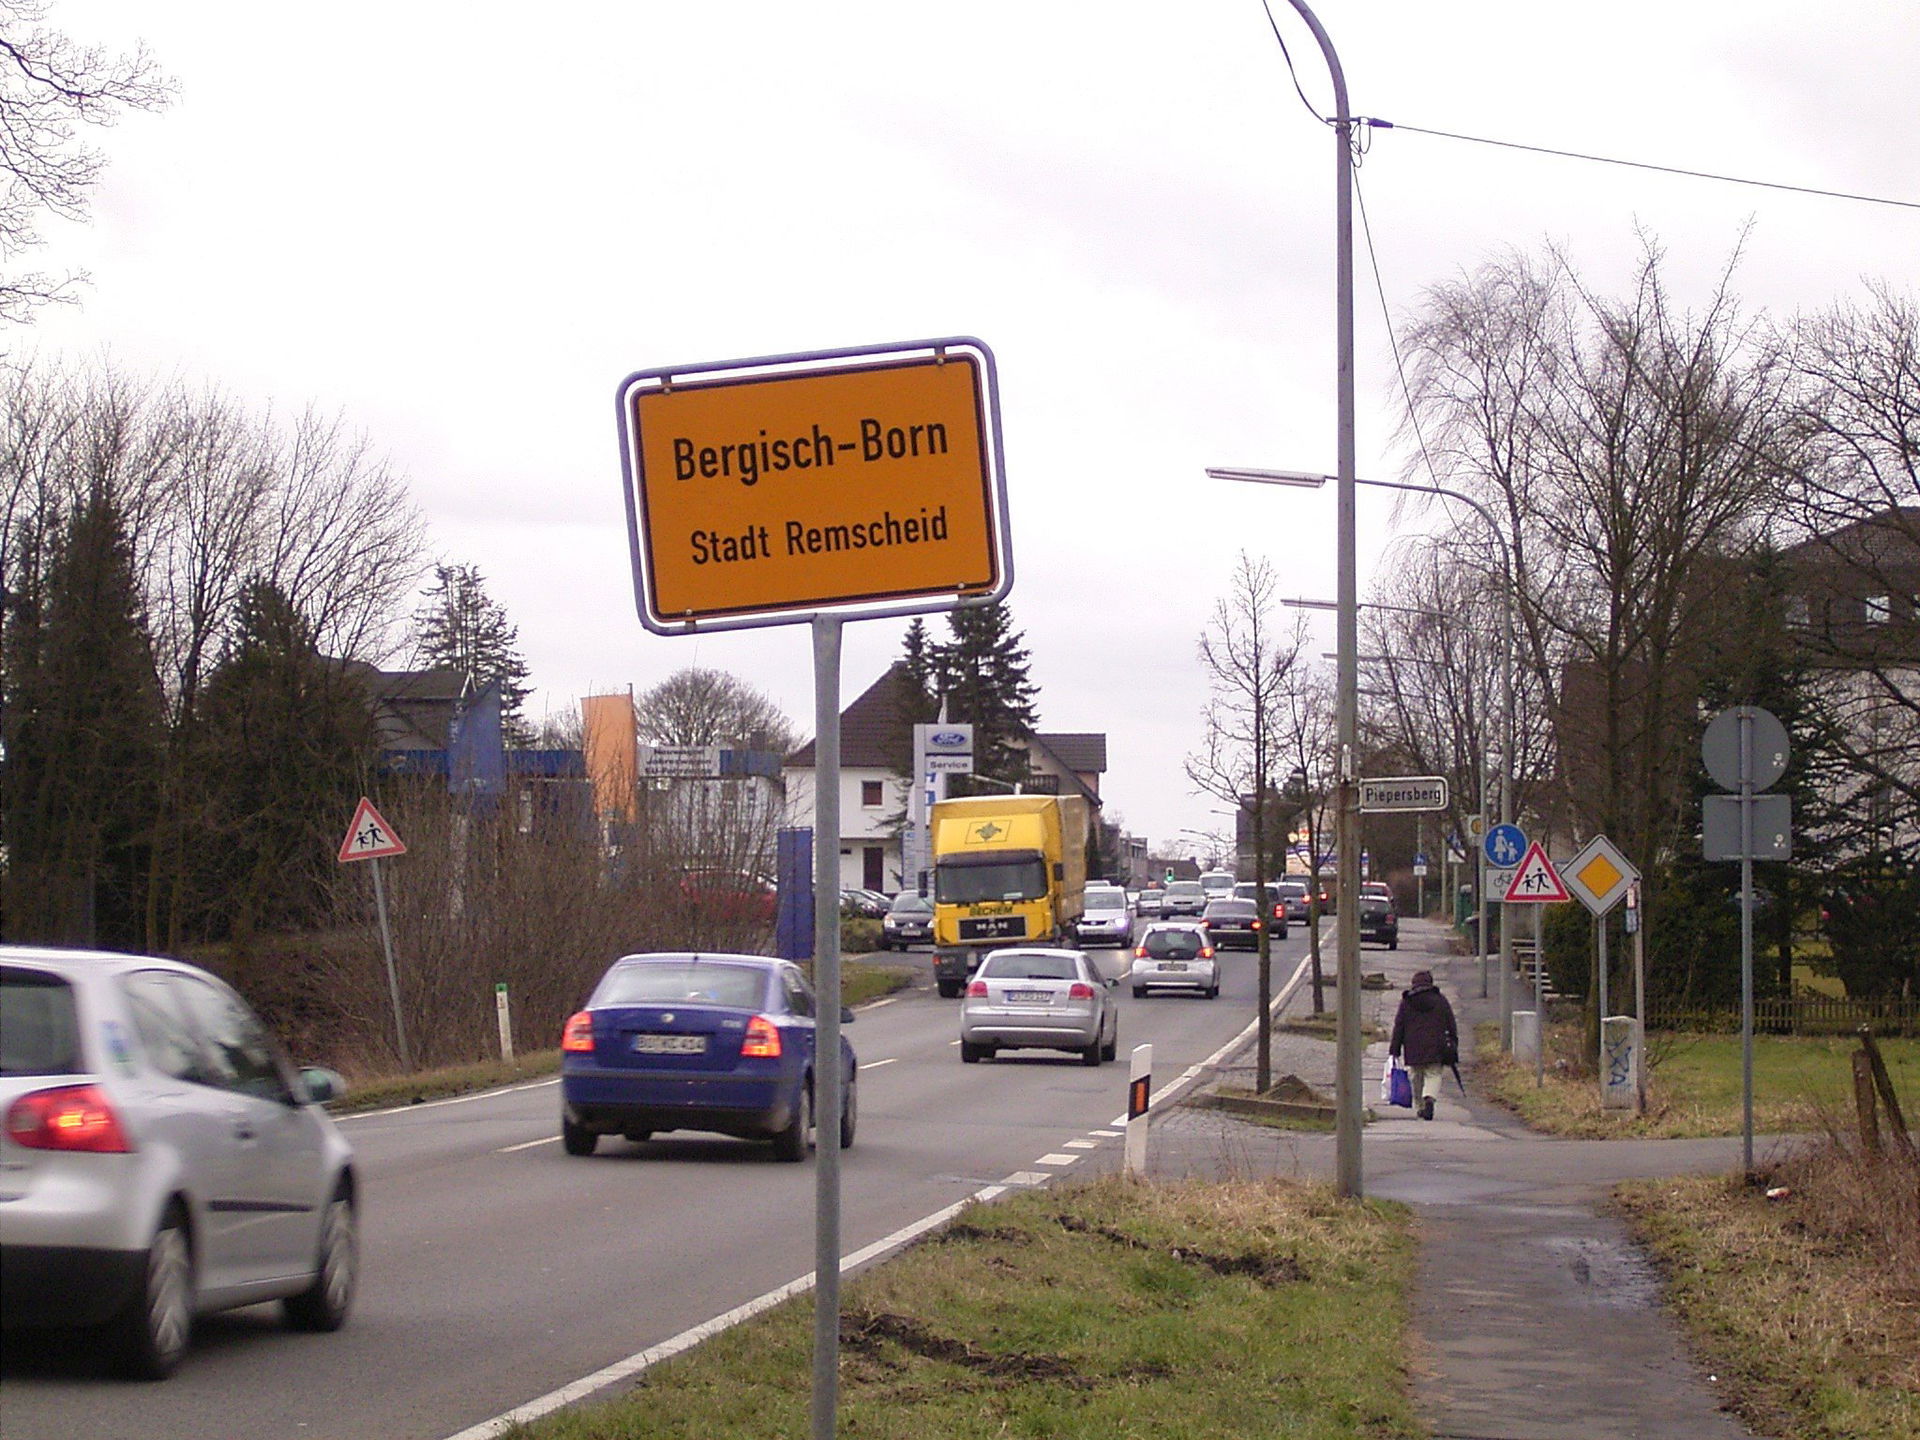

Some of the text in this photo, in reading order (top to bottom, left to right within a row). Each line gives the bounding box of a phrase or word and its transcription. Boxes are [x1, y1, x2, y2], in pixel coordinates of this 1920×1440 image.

[673, 418, 948, 486] Bergisch-Born
[690, 506, 948, 565] Stadt Remscheid
[930, 761, 968, 769] Service
[1366, 787, 1441, 803] Piepersberg
[976, 922, 1008, 930] MAN
